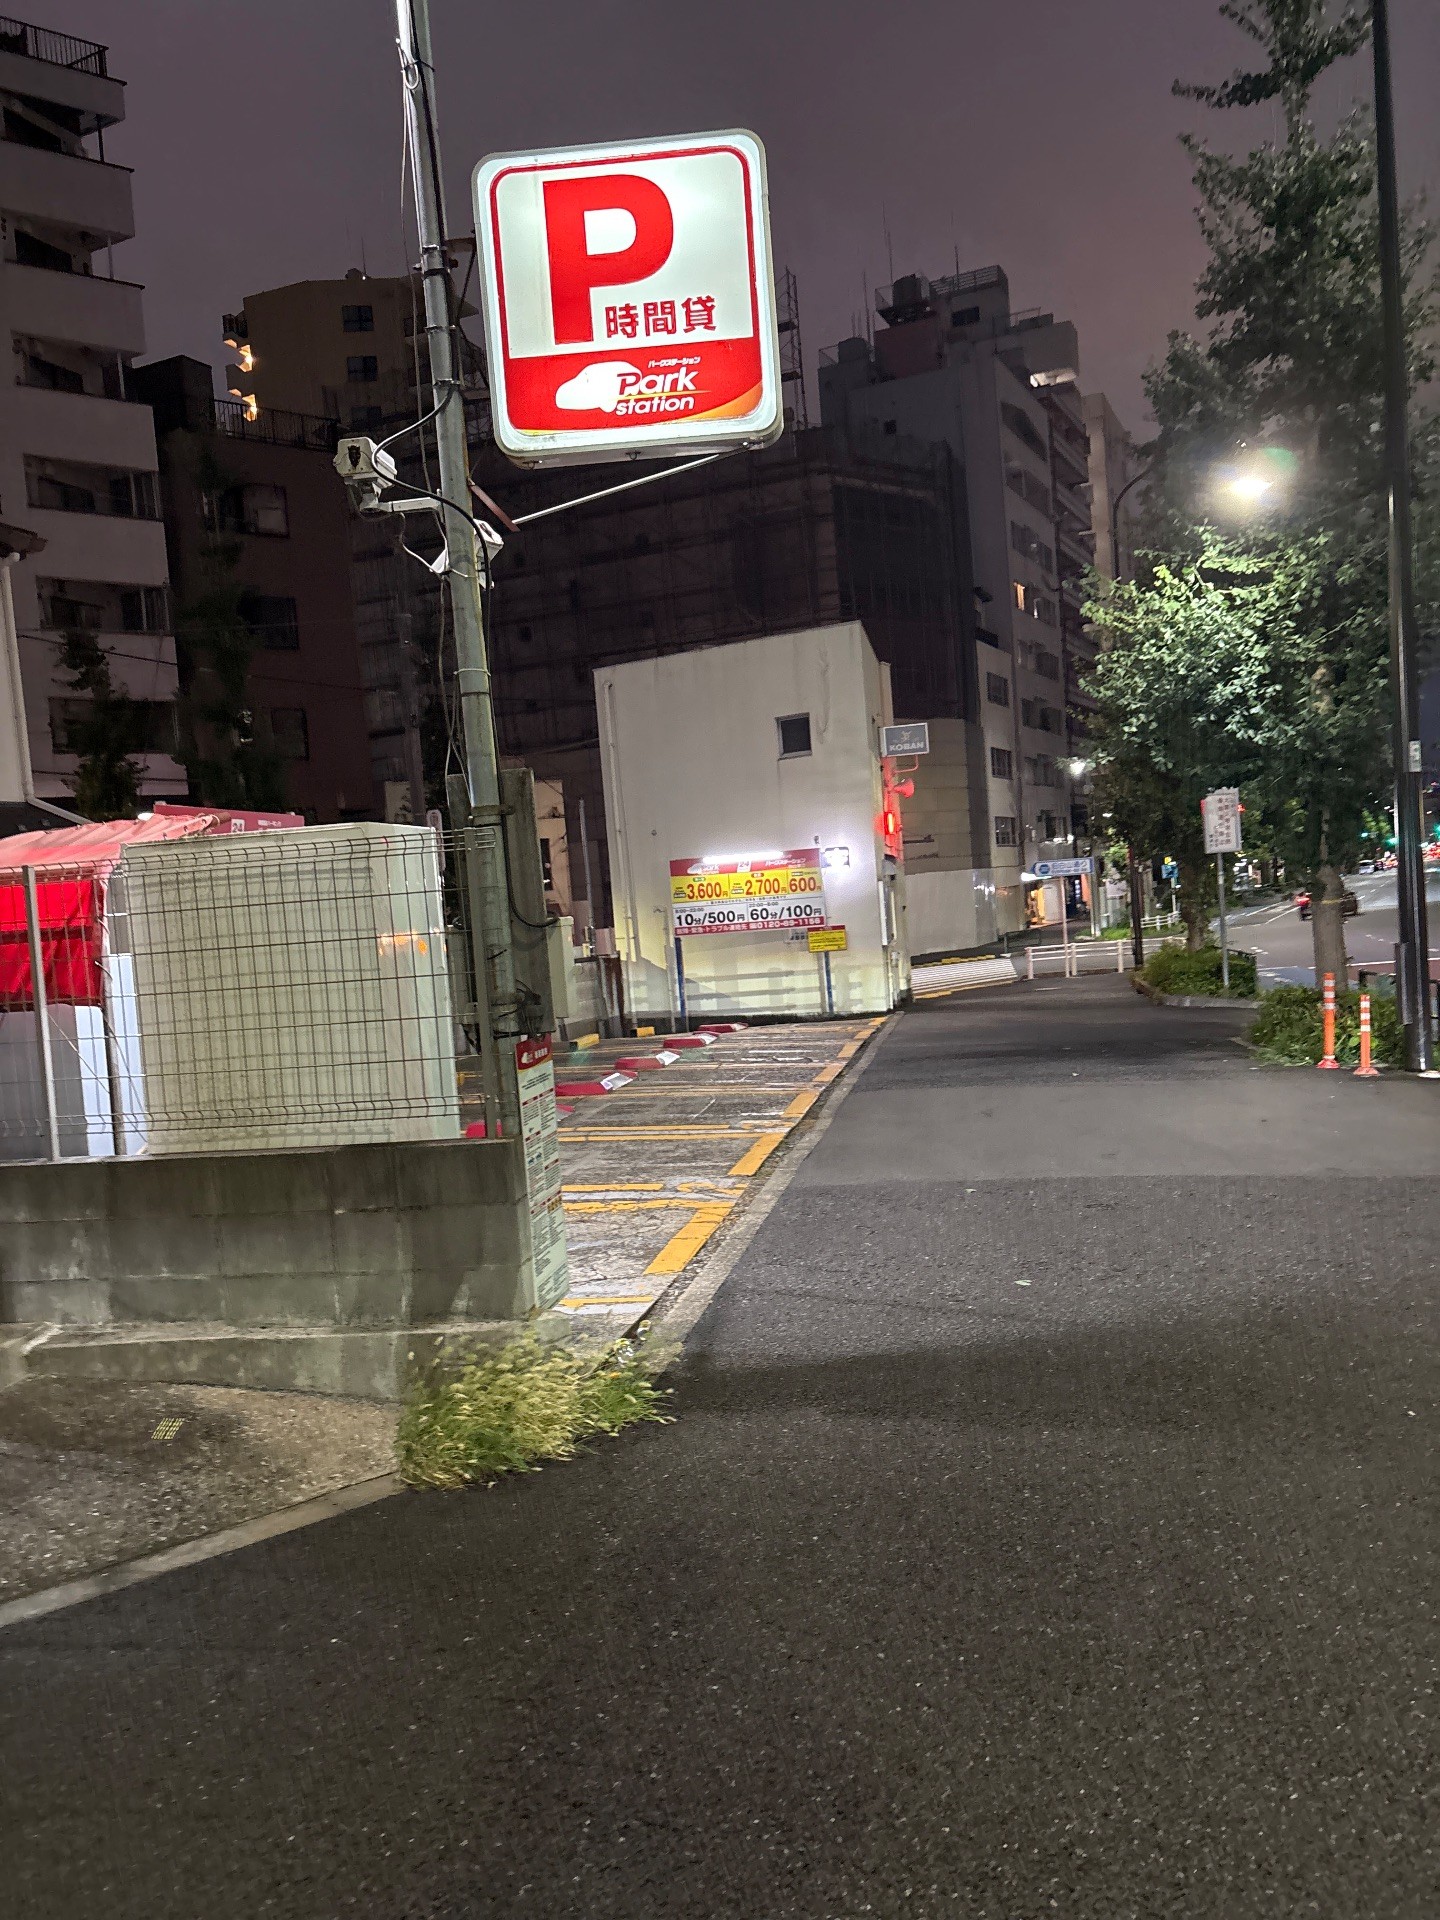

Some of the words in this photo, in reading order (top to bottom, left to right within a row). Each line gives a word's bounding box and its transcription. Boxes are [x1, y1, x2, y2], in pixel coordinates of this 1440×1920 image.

[543, 174, 673, 344] P
[605, 295, 717, 338] 時間貸
[617, 366, 699, 395] Park
[615, 395, 695, 416] station
[889, 741, 925, 751] KOBAN
[750, 904, 822, 920] 60分/100円
